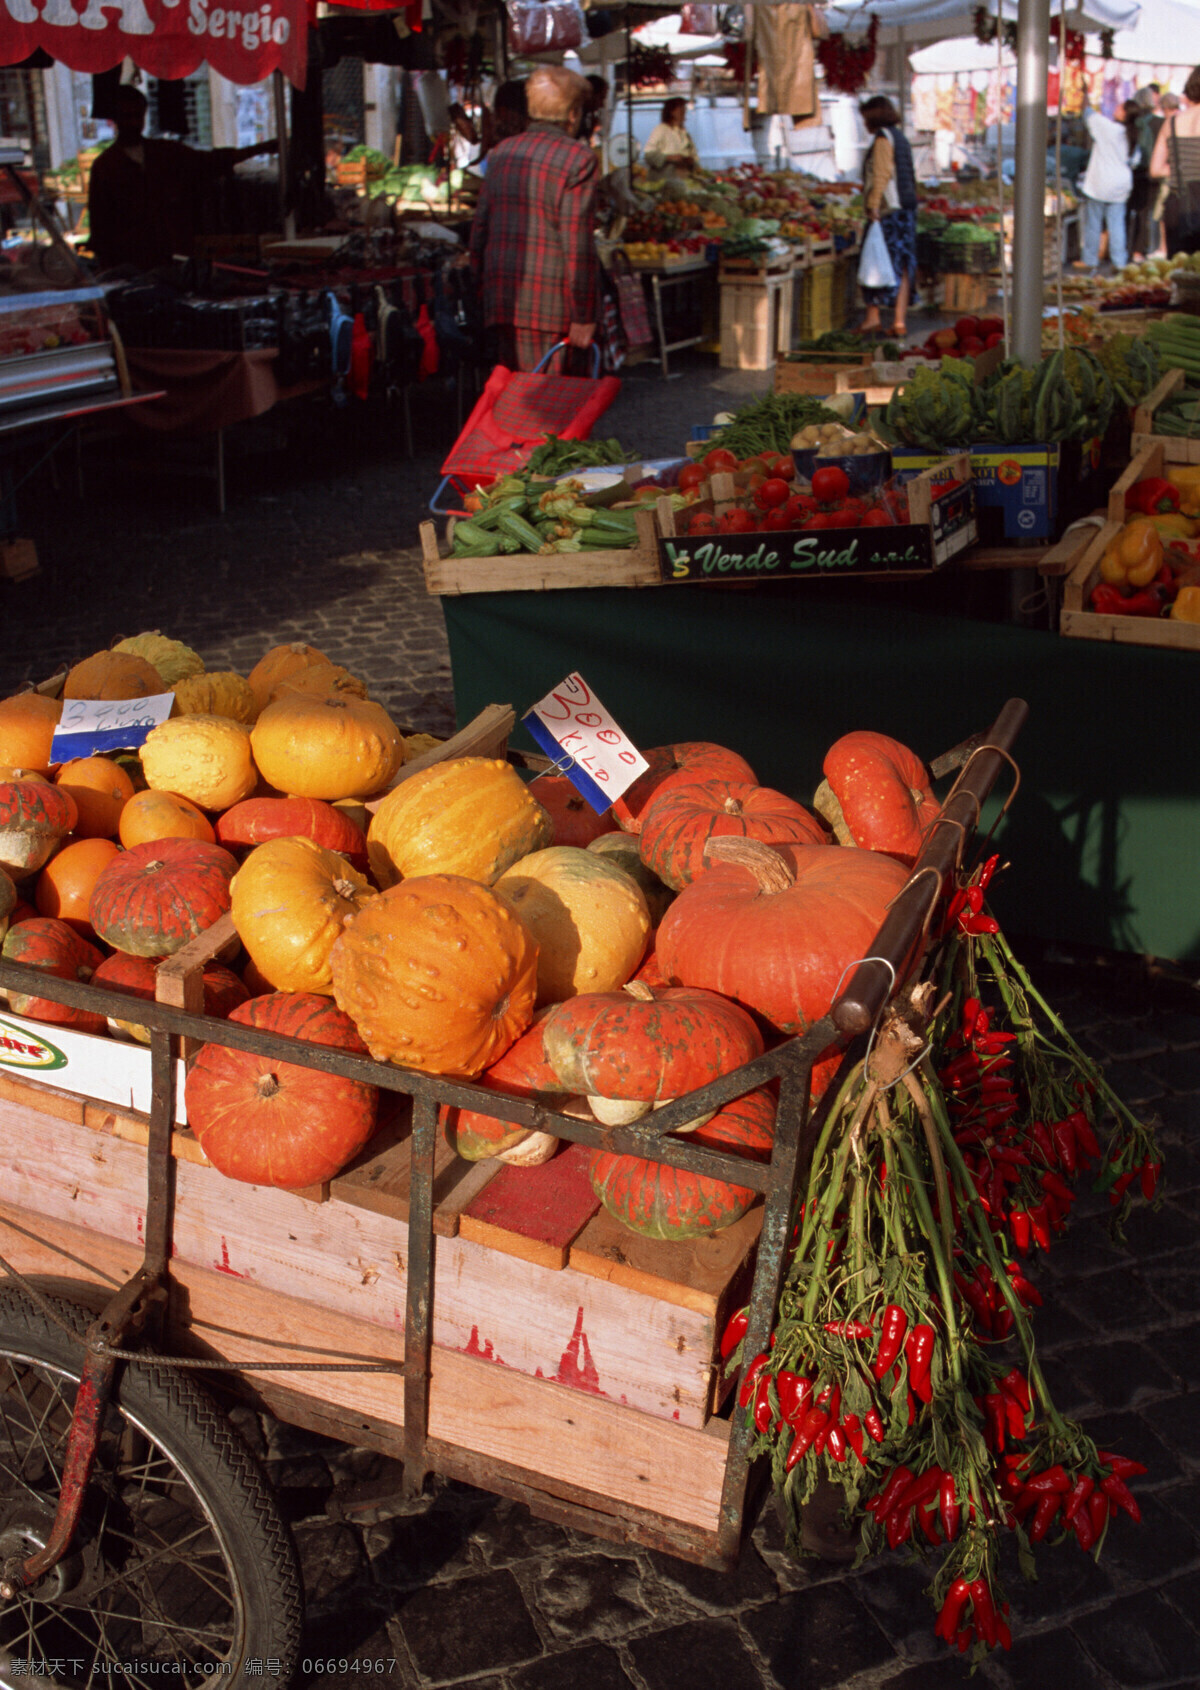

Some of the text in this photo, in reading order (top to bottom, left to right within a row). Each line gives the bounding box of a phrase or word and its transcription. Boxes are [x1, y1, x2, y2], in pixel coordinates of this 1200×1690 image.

[187, 0, 290, 50] Sergio
[694, 542, 780, 573] Verde
[790, 537, 858, 569] Sud
[558, 730, 609, 782] KILO
